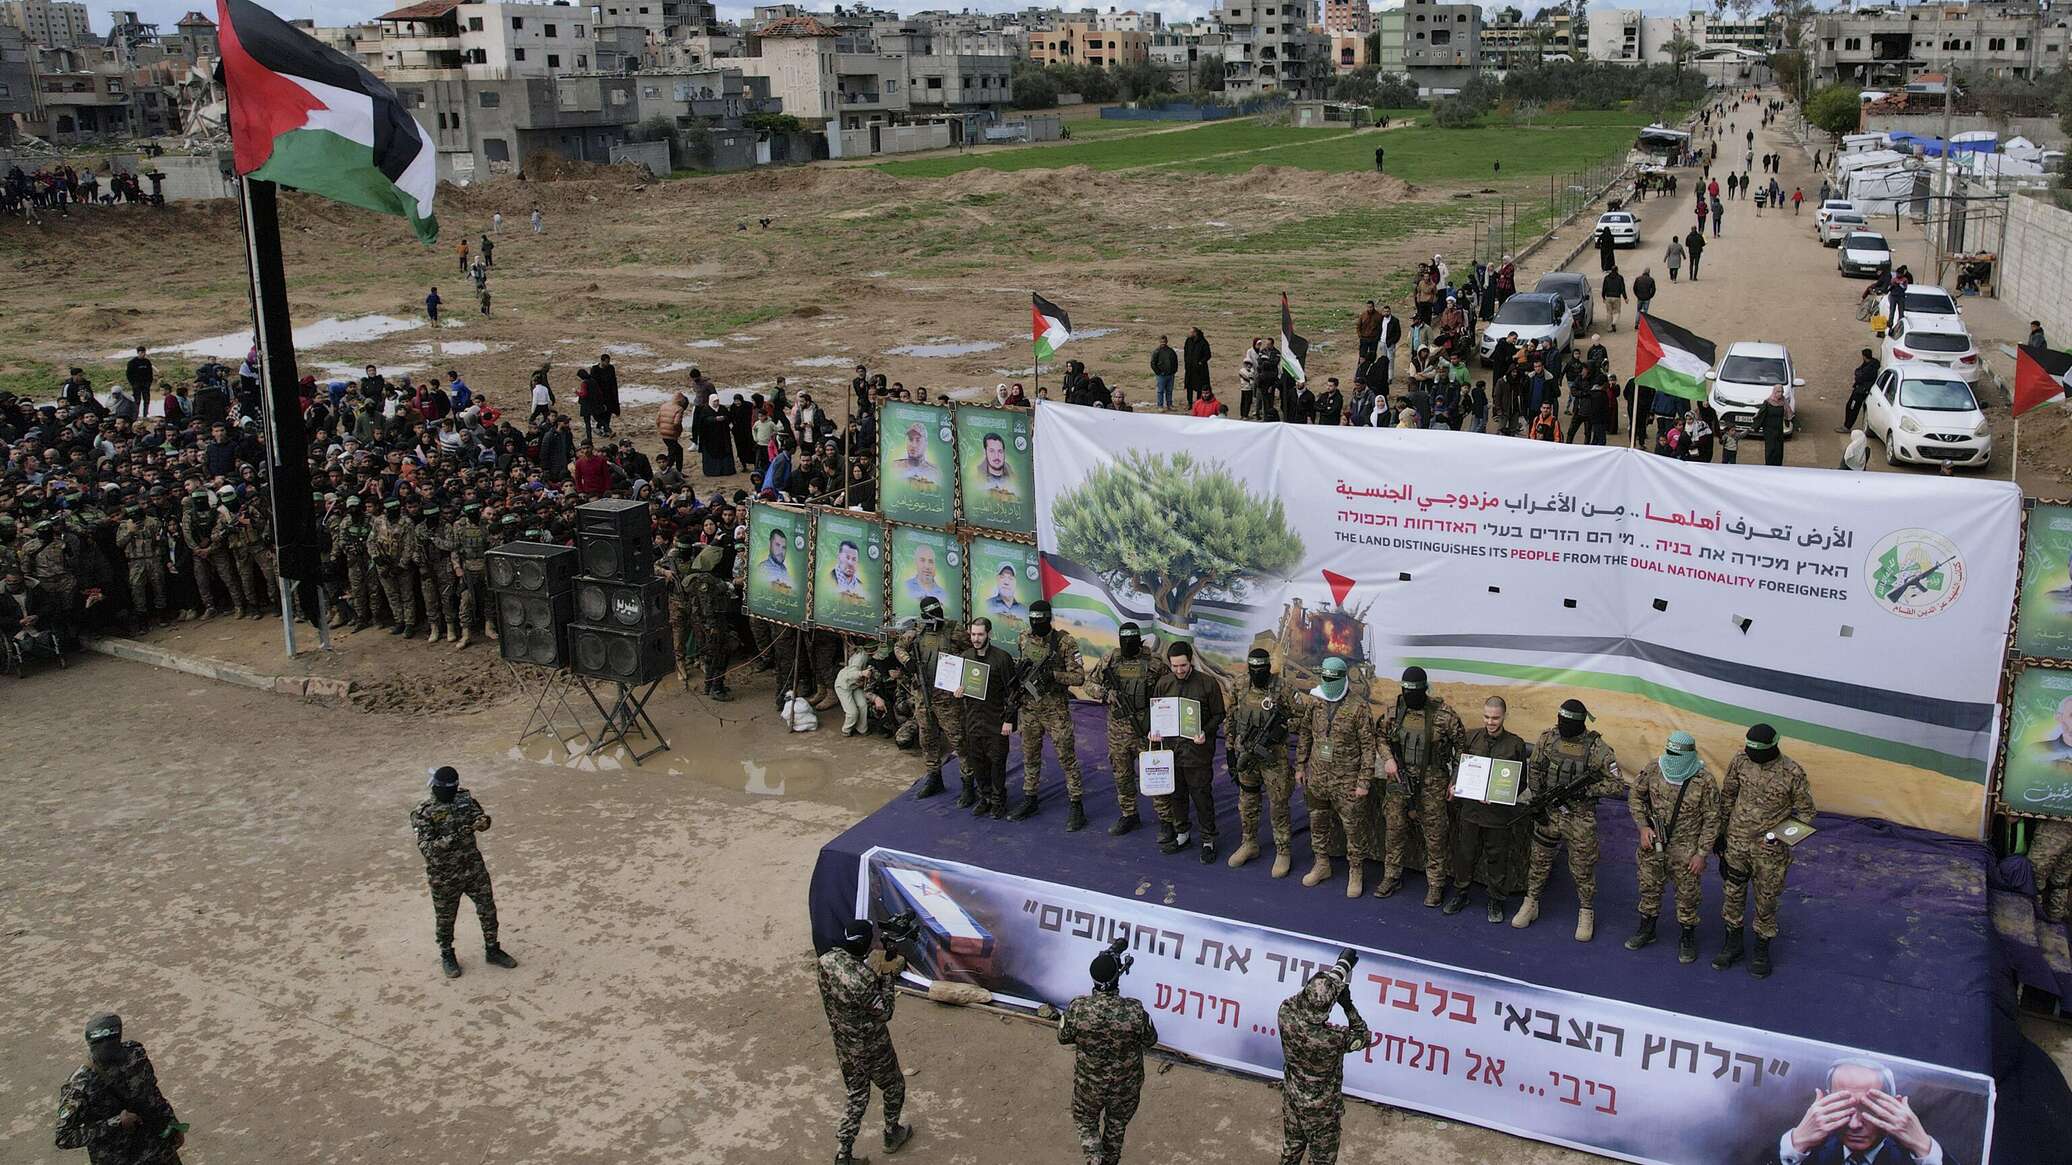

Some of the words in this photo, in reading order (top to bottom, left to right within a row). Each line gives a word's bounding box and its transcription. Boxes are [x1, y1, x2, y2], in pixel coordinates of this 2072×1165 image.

[1336, 480, 1412, 503] الجنسية
[1417, 491, 1499, 511] مزدوجي
[1504, 492, 1576, 515] الأغراب
[1338, 510, 1397, 527] הכפולה
[1403, 517, 1477, 534] האזרחות
[1645, 502, 1721, 531] أهلها
[1483, 522, 1523, 538] בעלי
[1530, 528, 1579, 542] הזרים
[1587, 531, 1612, 543] הם
[1619, 532, 1634, 545] מי
[1726, 516, 1792, 541] تعرف
[1797, 526, 1853, 550] الأرض
[1656, 539, 1692, 556] בניה
[1698, 546, 1725, 561] את
[1334, 531, 1357, 543] THE
[1359, 534, 1390, 547] LAND
[1489, 547, 1508, 558] ITS
[1511, 549, 1560, 562] PEOPLE
[1563, 552, 1600, 564] FROM
[1604, 554, 1628, 566] THE
[1630, 557, 1664, 573] DUAL
[1668, 564, 1755, 588] NATIONALITY
[1759, 579, 1848, 600] FOREIGNERS
[1731, 552, 1789, 571] מכירה
[1796, 561, 1848, 578] הארץ
[1195, 939, 1252, 975] את
[1154, 982, 1240, 1028] תירגע
[1368, 973, 1477, 1025] בלבד
[1494, 1001, 1625, 1057] הצבאי
[1364, 1030, 1450, 1075] תלחץ
[1465, 1048, 1505, 1087] אל
